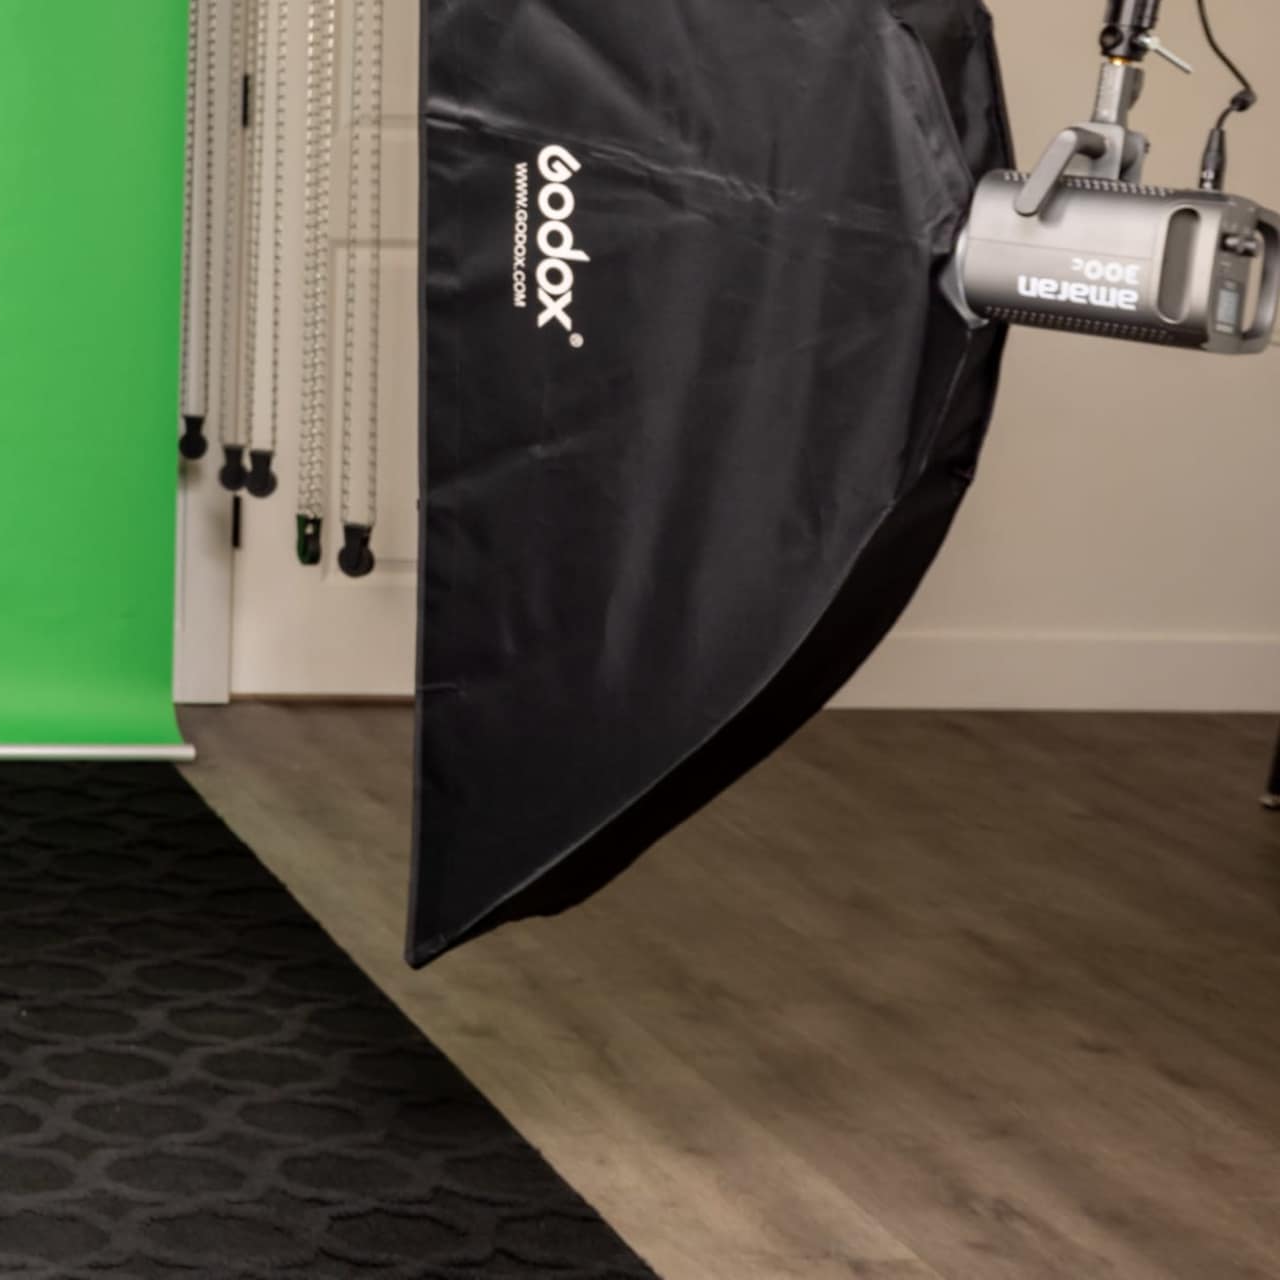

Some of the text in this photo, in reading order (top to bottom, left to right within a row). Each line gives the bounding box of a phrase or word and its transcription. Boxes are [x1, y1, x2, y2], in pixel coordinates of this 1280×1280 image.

[512, 162, 528, 307] WWW.GODOX.COM
[536, 144, 590, 331] Godox
[1071, 257, 1140, 285] 300c
[1017, 275, 1139, 311] amaran
